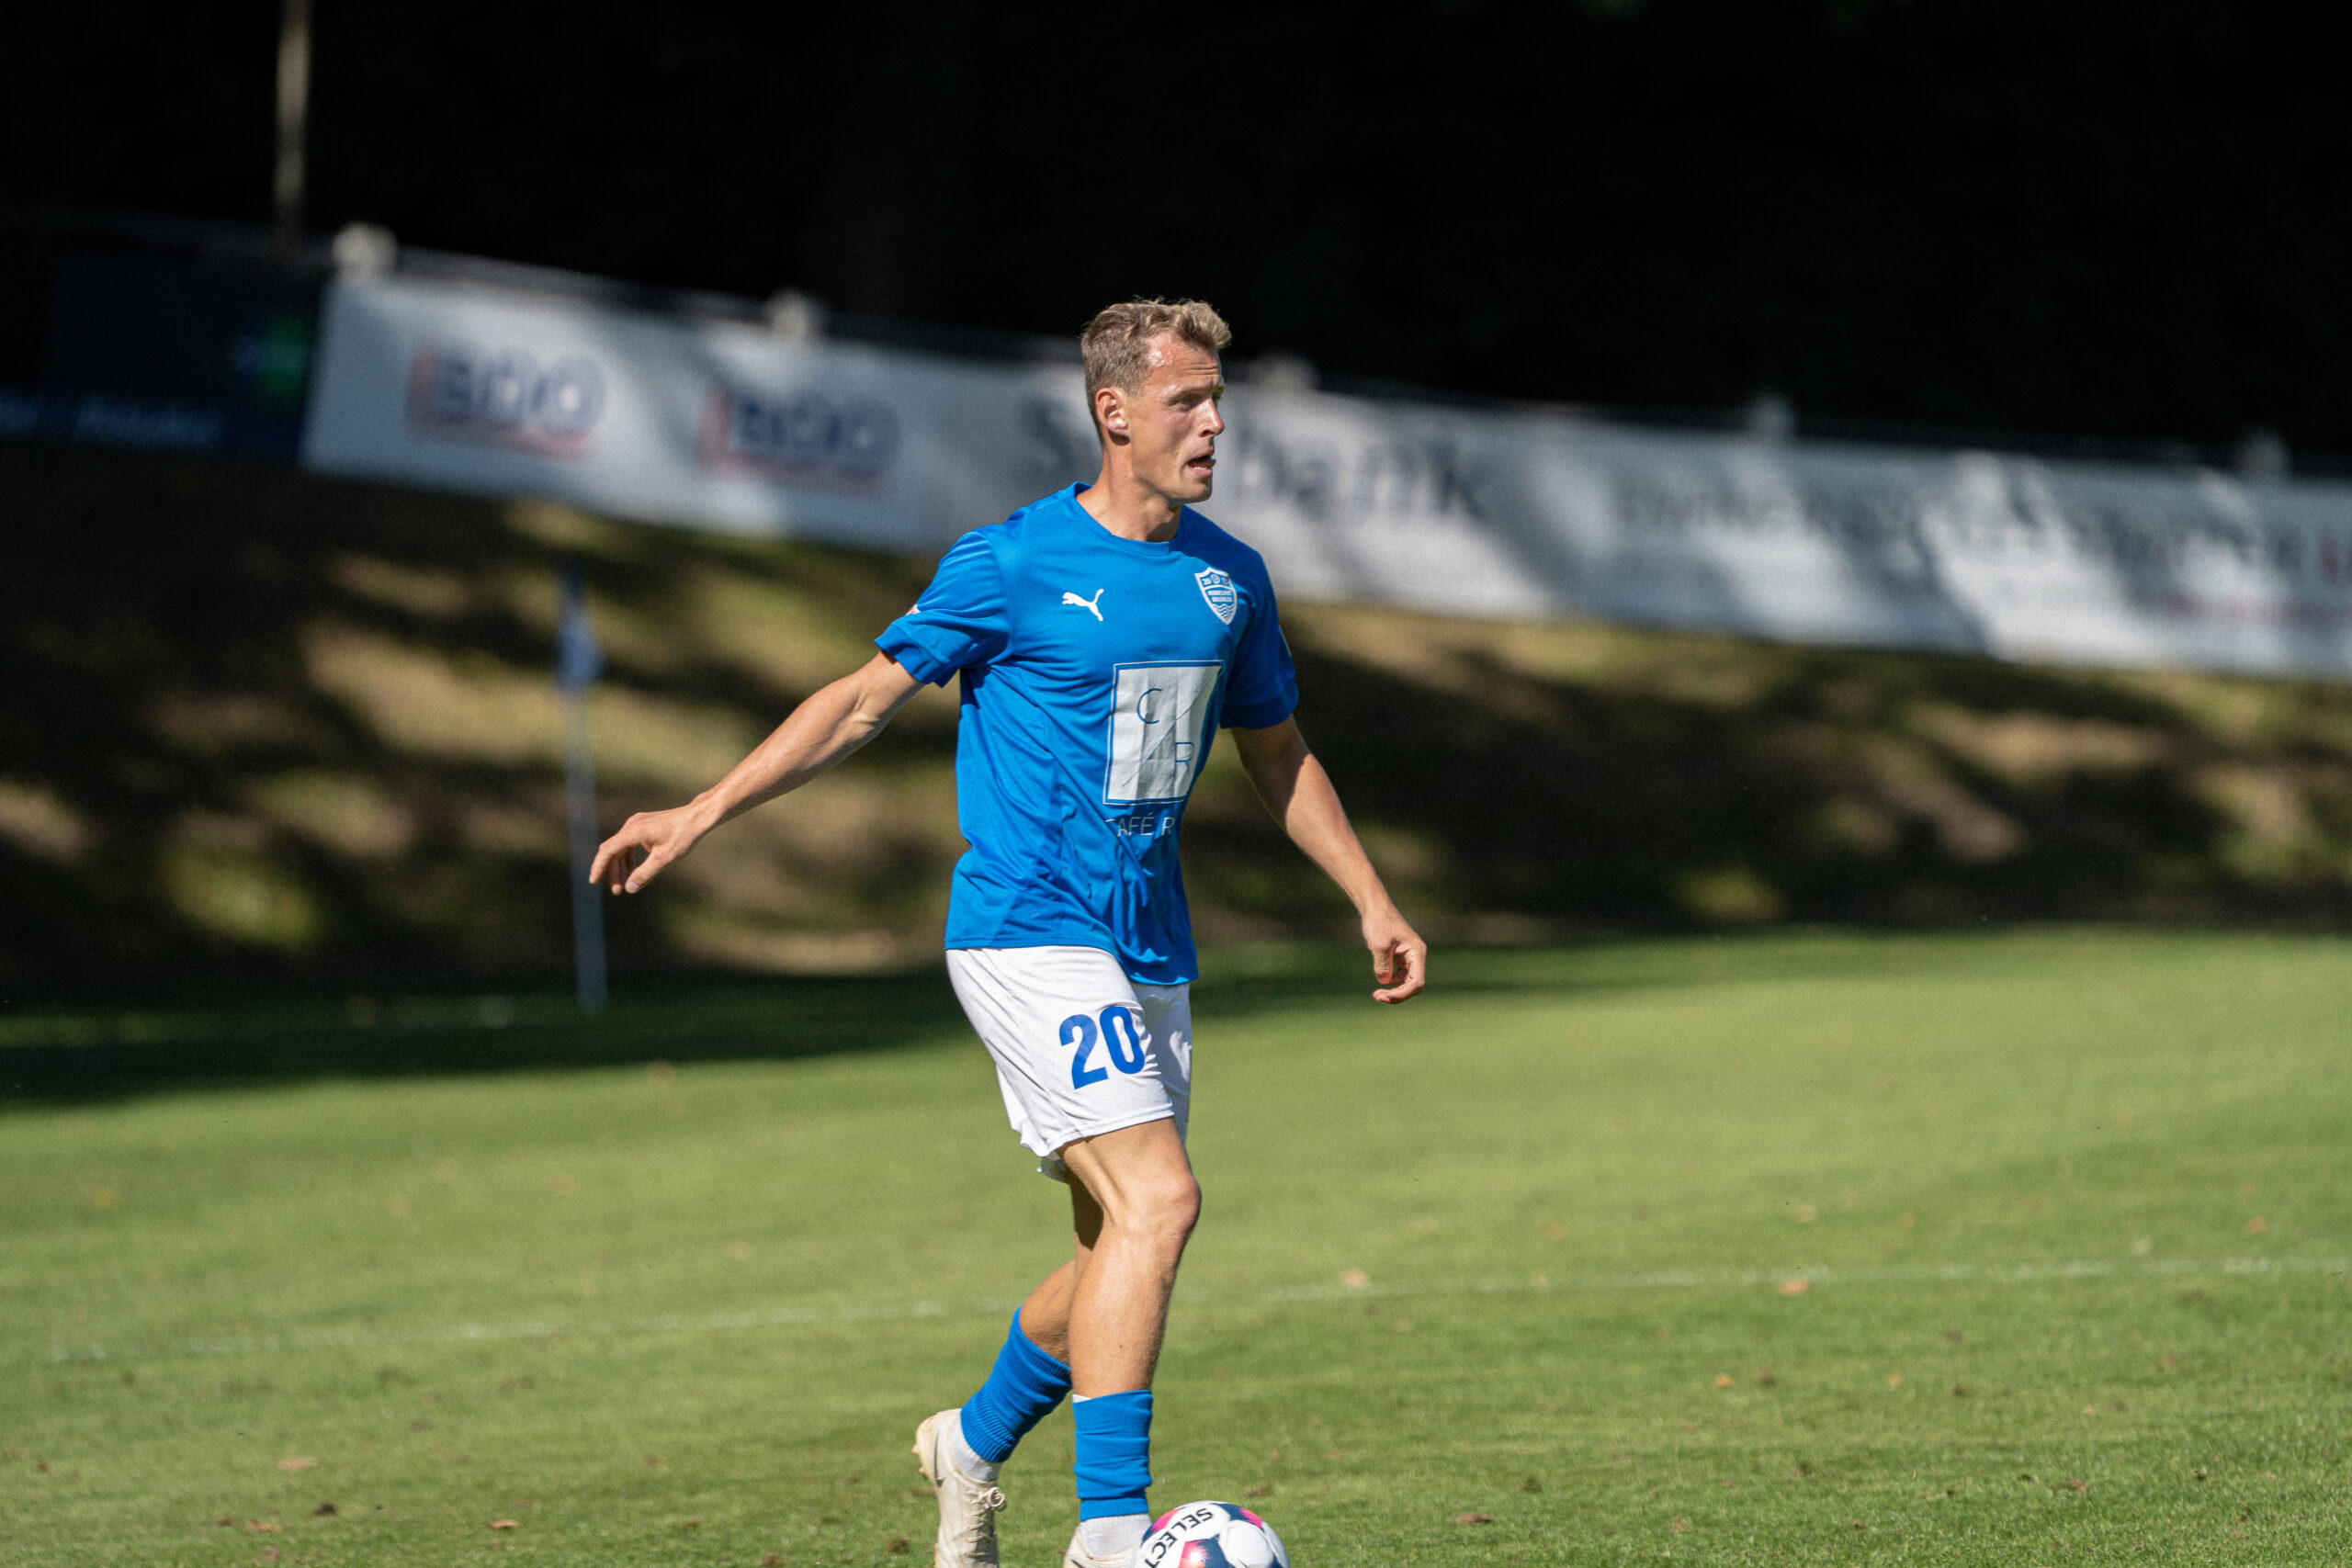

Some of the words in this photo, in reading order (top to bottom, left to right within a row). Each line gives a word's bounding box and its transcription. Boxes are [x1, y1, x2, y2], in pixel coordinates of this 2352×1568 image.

[1136, 687, 1162, 725] C
[1172, 741, 1194, 779] R
[1104, 811, 1155, 836] AFÉ
[1059, 1006, 1145, 1089] 20
[1145, 1507, 1213, 1568] SELECT
